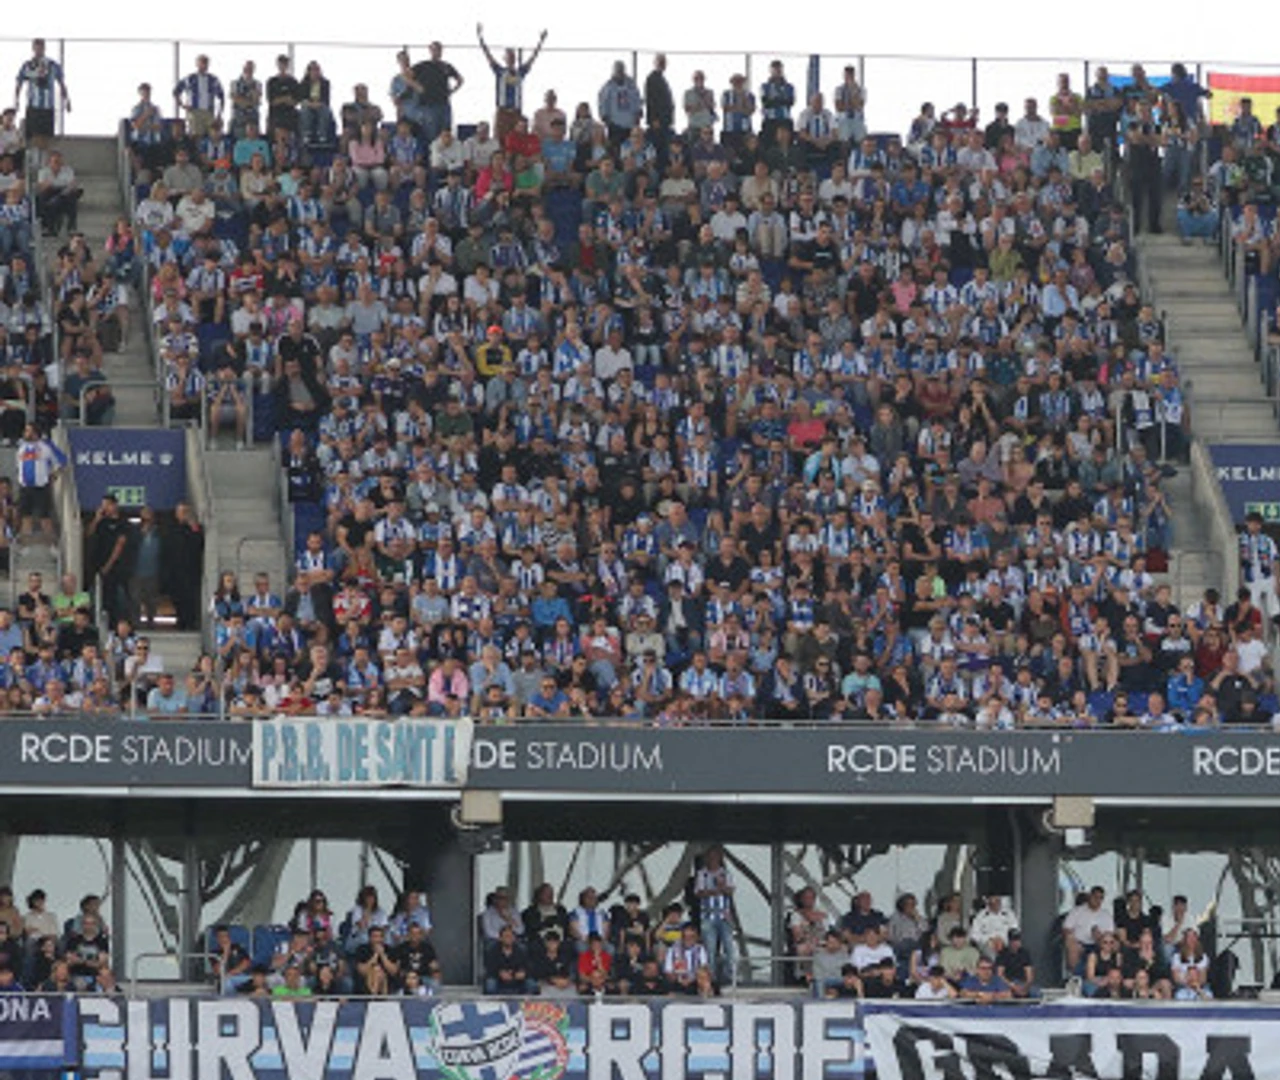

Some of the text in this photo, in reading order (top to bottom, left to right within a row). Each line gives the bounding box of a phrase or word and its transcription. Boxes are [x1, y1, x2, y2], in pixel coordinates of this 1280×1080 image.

[77, 452, 153, 465] KELME
[21, 733, 252, 766] RCDE STADIUM
[337, 723, 369, 781] DE
[376, 722, 435, 783] SANT
[474, 740, 662, 770] DE STADIUM
[827, 744, 1060, 775] RCDE STADIUM
